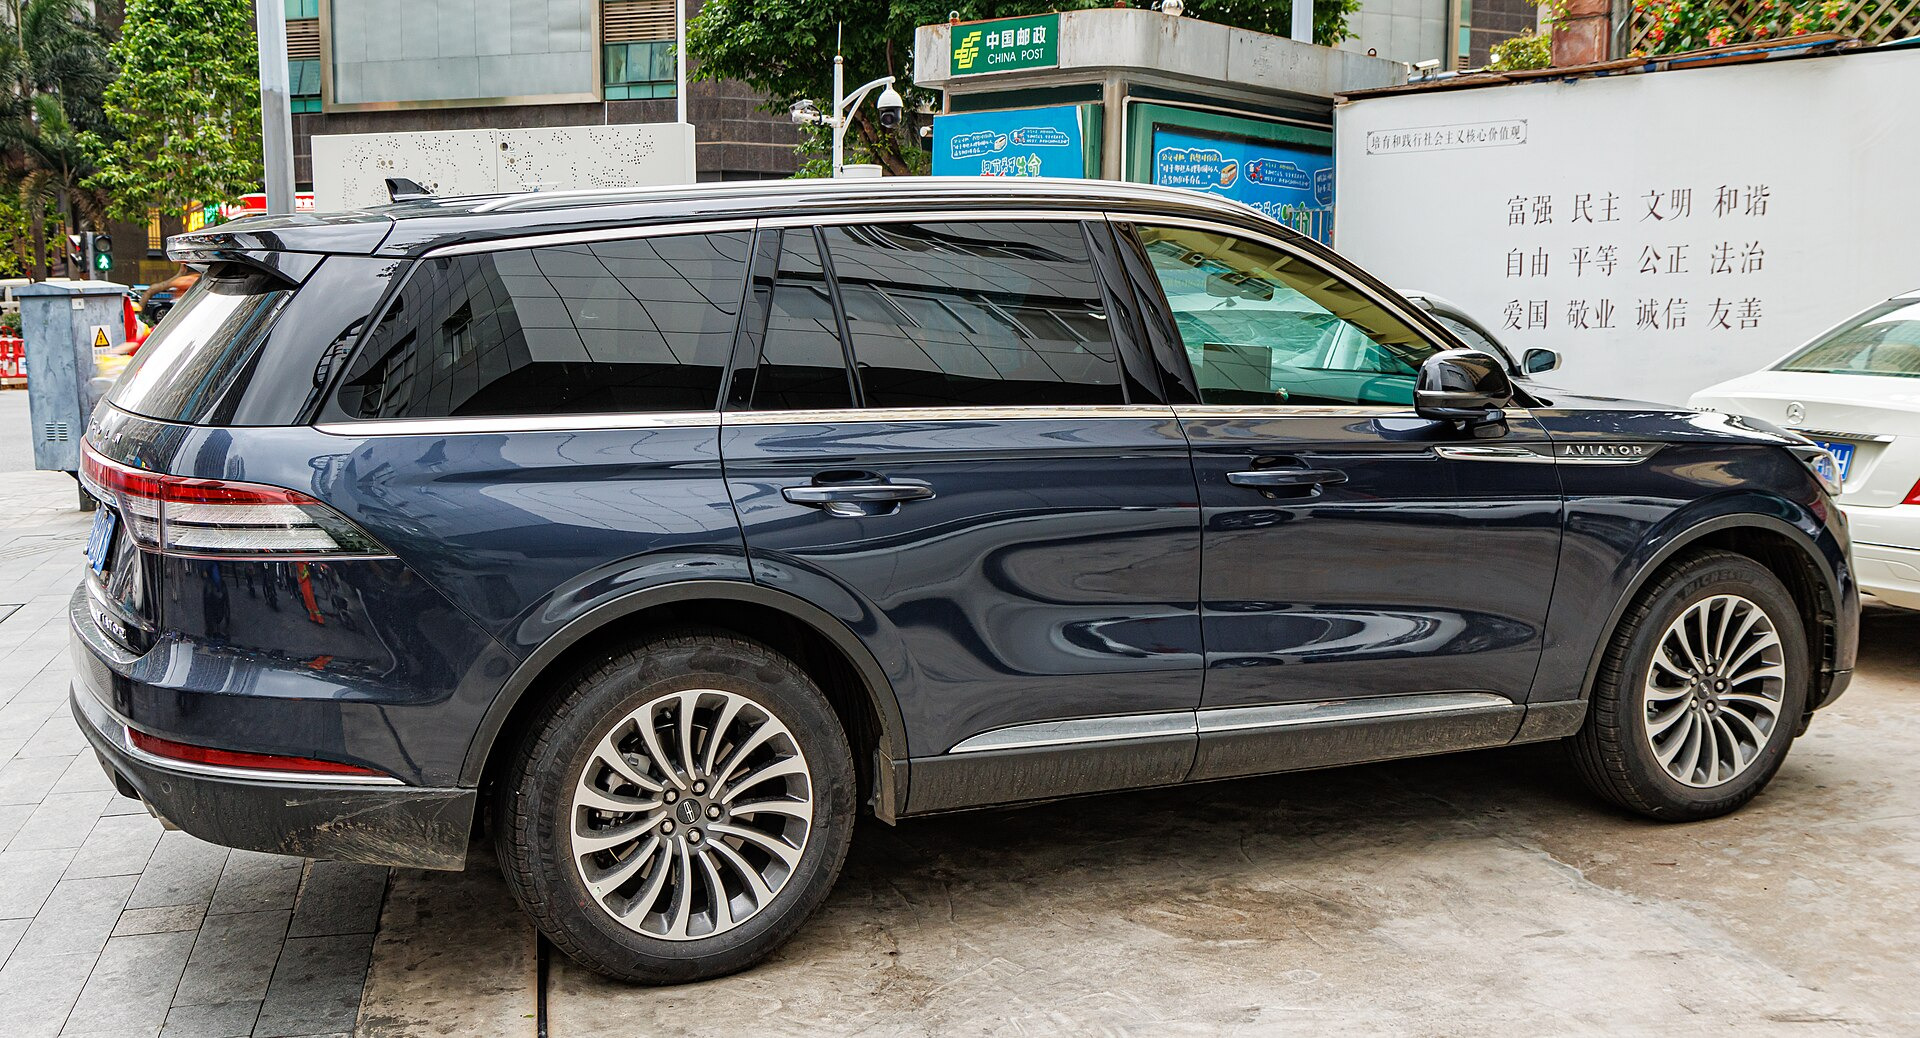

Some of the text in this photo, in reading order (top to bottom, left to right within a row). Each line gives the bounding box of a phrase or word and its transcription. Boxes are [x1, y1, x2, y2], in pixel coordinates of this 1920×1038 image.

[986, 25, 1047, 50] 中国邮政
[987, 48, 1044, 65] CHINA POST
[1371, 125, 1521, 150] 培育和践行社会主义核心价值观
[1507, 184, 1770, 226] 富强 民主 文明 和谐
[1506, 240, 1765, 278] 自由 平等 公正 法治
[1501, 297, 1762, 331] 爱国 敬业 诚信 友善
[1565, 445, 1642, 455] AVIATOR
